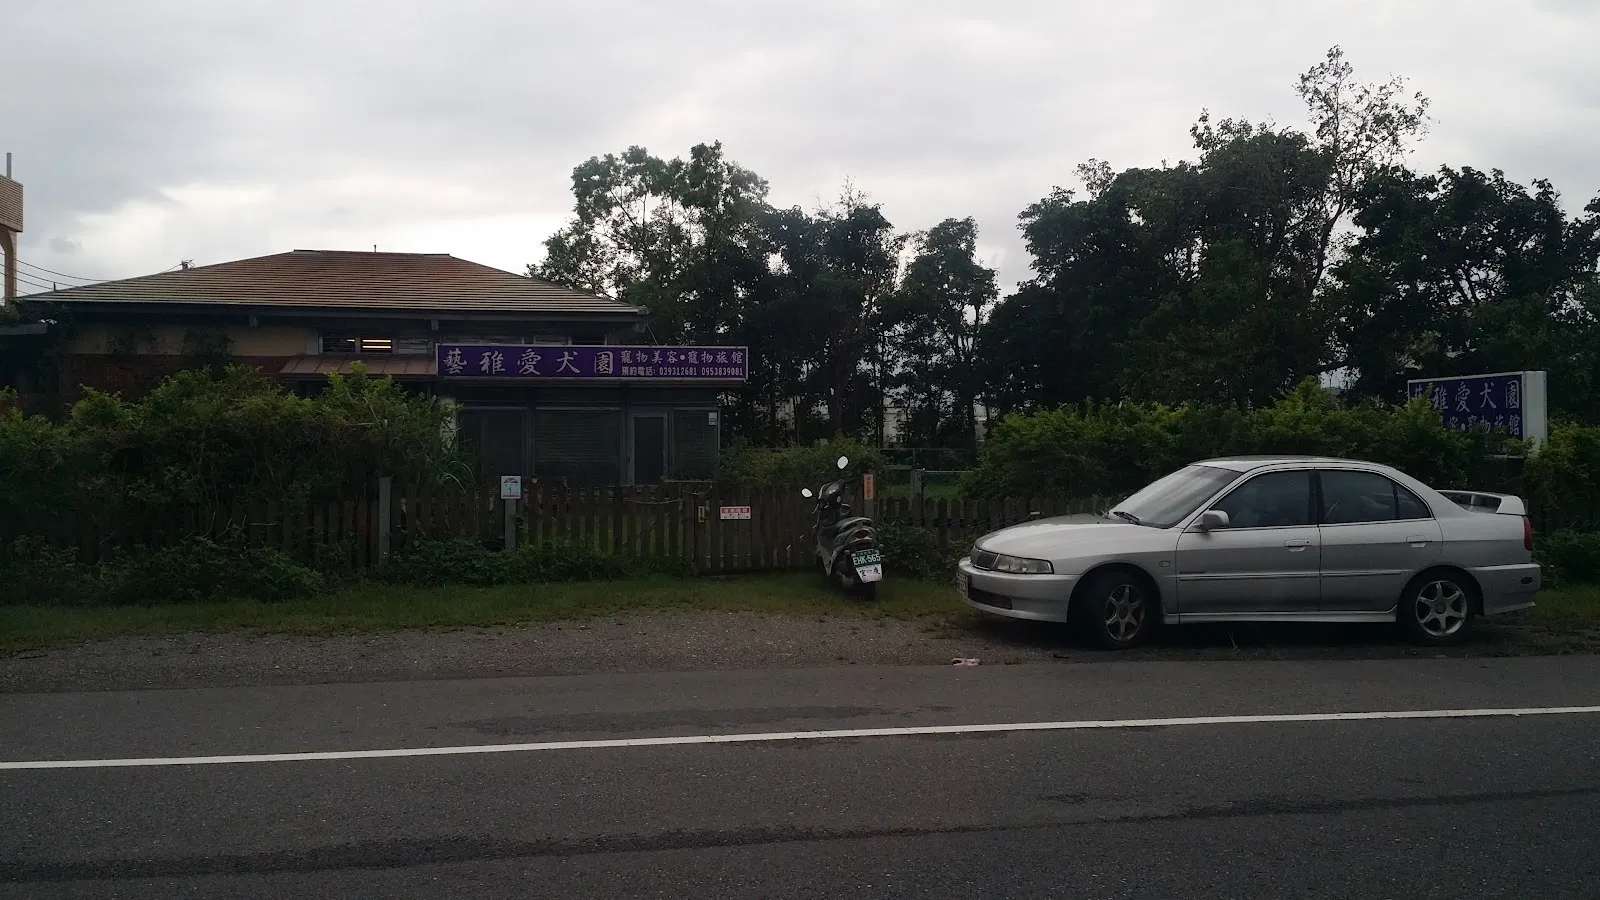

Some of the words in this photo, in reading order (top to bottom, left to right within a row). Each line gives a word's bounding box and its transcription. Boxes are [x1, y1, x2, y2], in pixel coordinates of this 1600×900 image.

[443, 348, 614, 375] 藝雅愛犬園
[659, 366, 697, 376] 039312681
[853, 554, 881, 565] EHK-565
